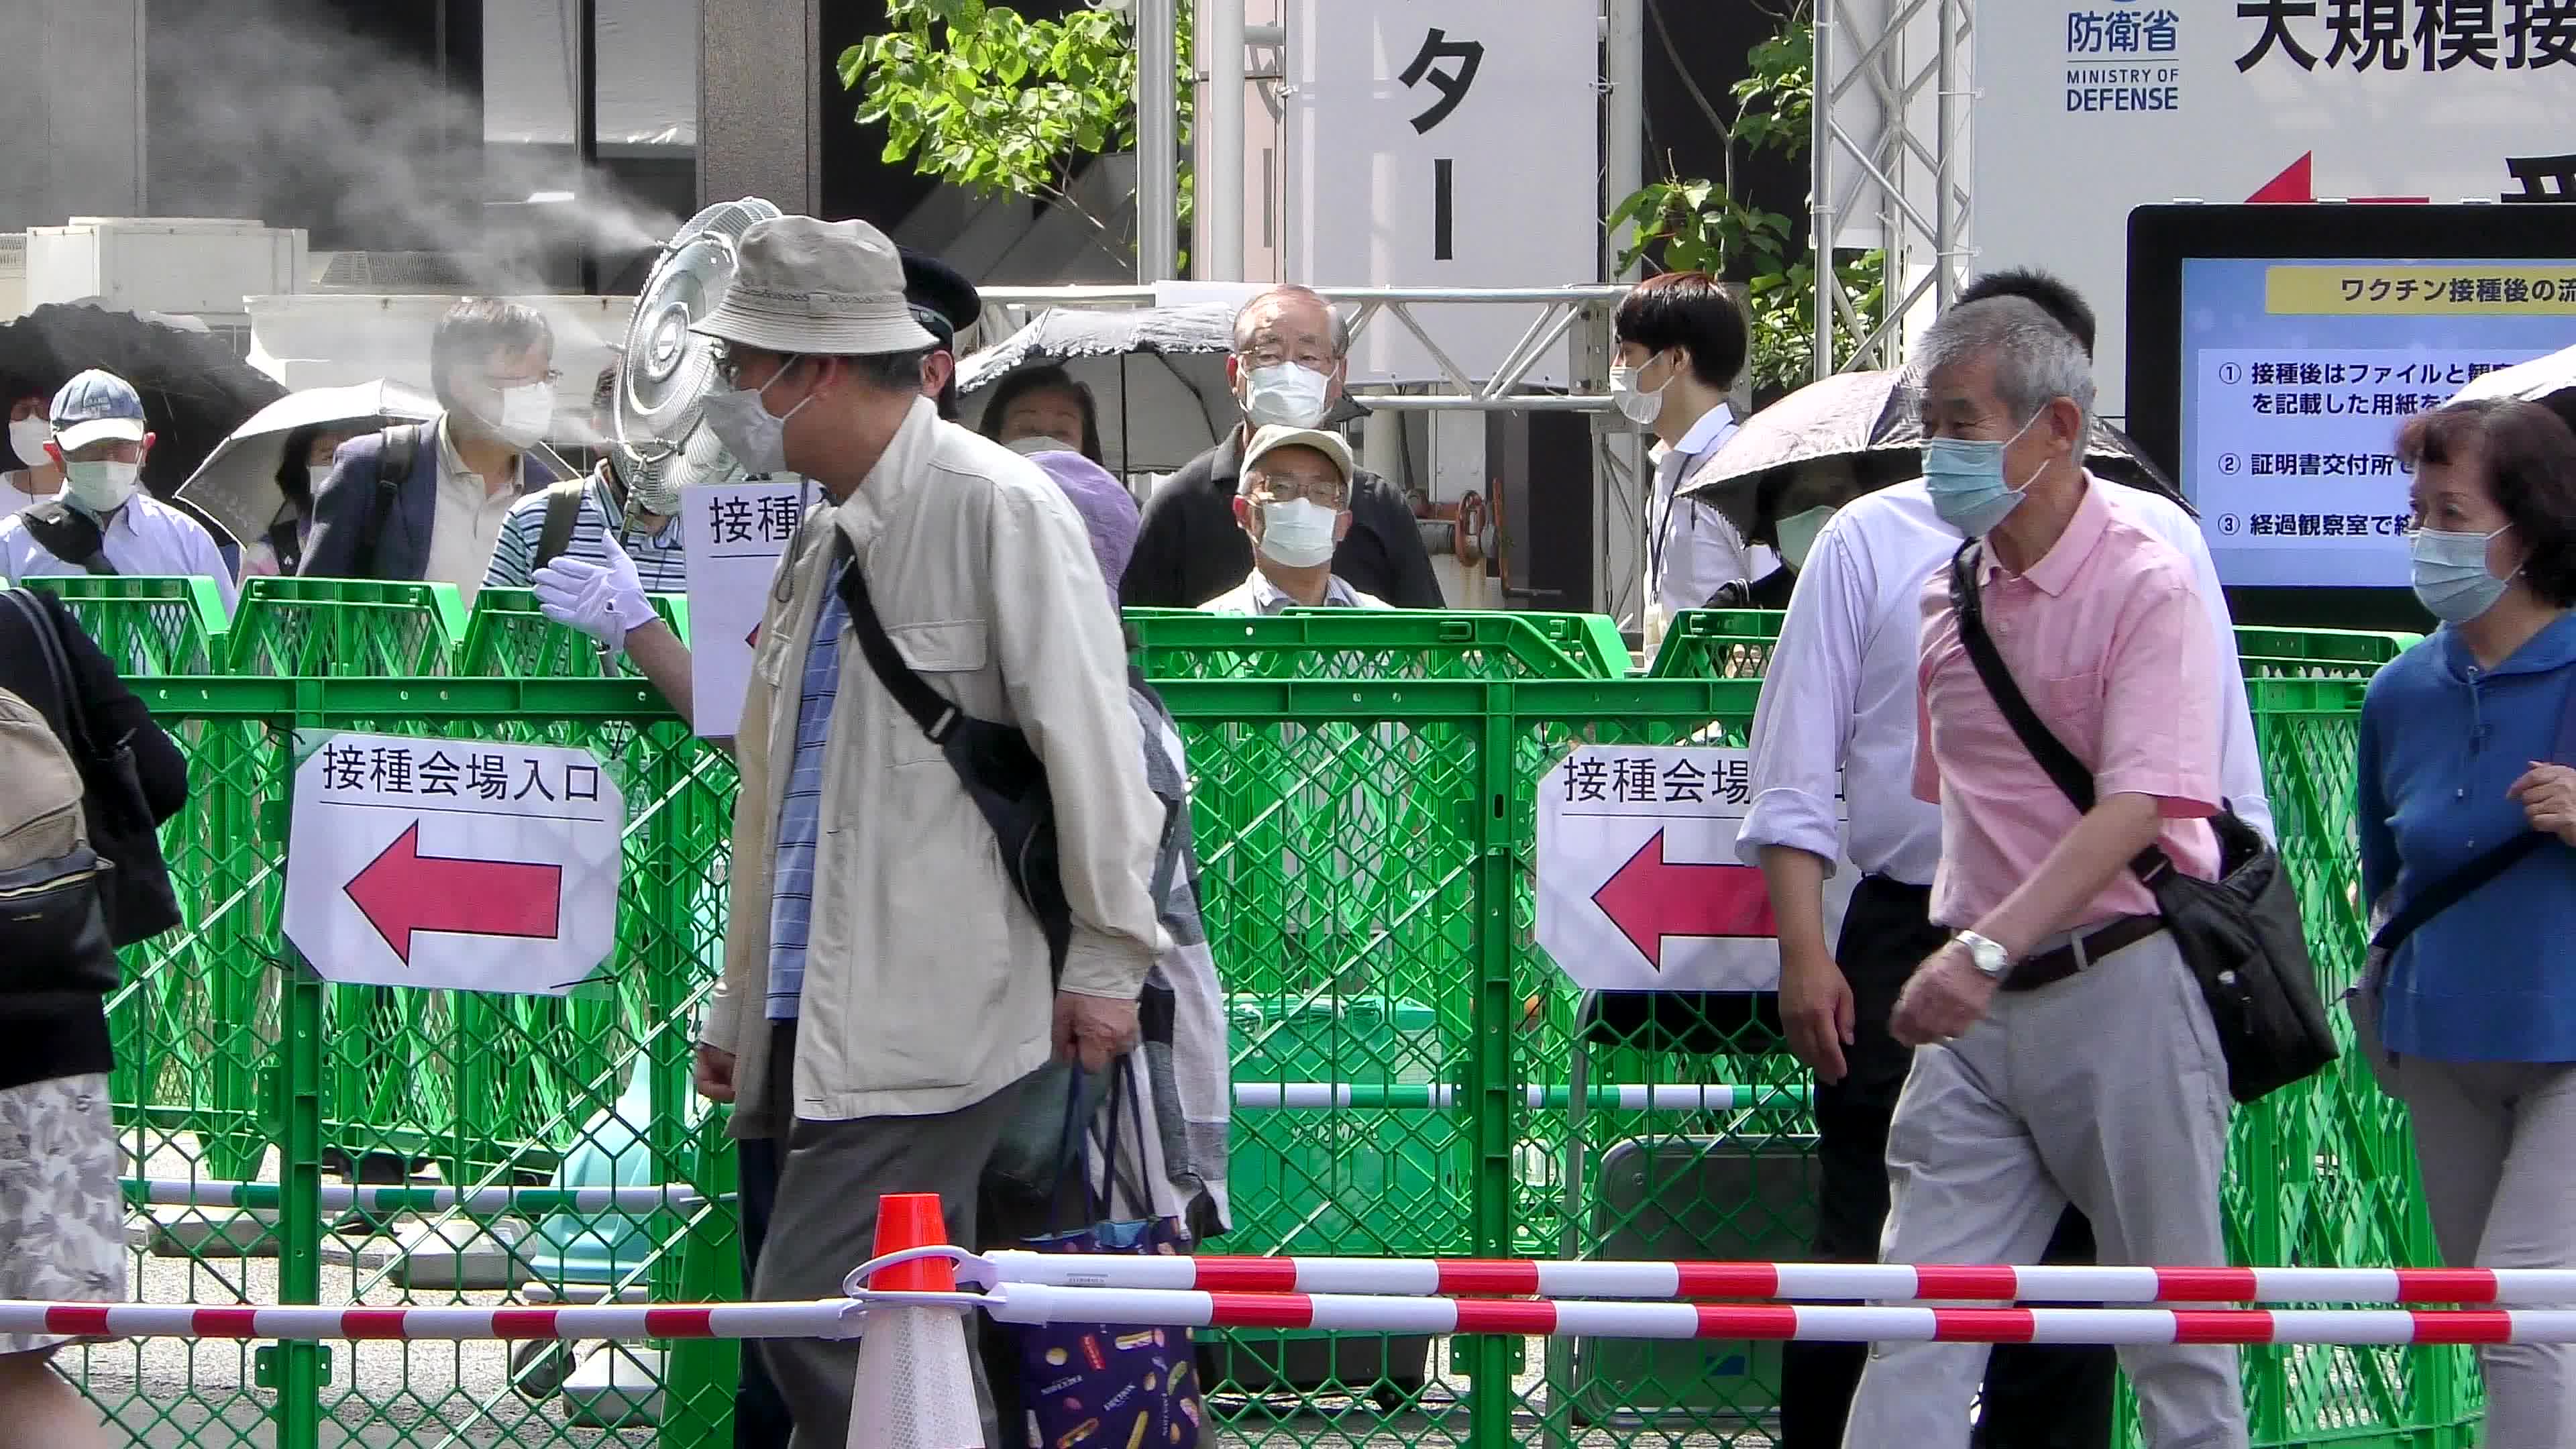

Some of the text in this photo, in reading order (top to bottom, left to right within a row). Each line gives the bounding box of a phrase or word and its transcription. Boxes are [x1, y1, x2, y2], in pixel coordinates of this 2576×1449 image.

[2068, 10, 2180, 53] 防衛省
[2067, 68, 2179, 85] MINISTRY OF
[2067, 87, 2178, 111] DEFENSE
[1399, 28, 1485, 260] ター
[2342, 278, 2576, 303] ワクチン接種後の流
[2253, 393, 2455, 416] を記載した用紙を
[709, 495, 799, 544] 接種
[323, 744, 598, 802] 接種会場入口
[1564, 756, 1846, 804] 接種会場
